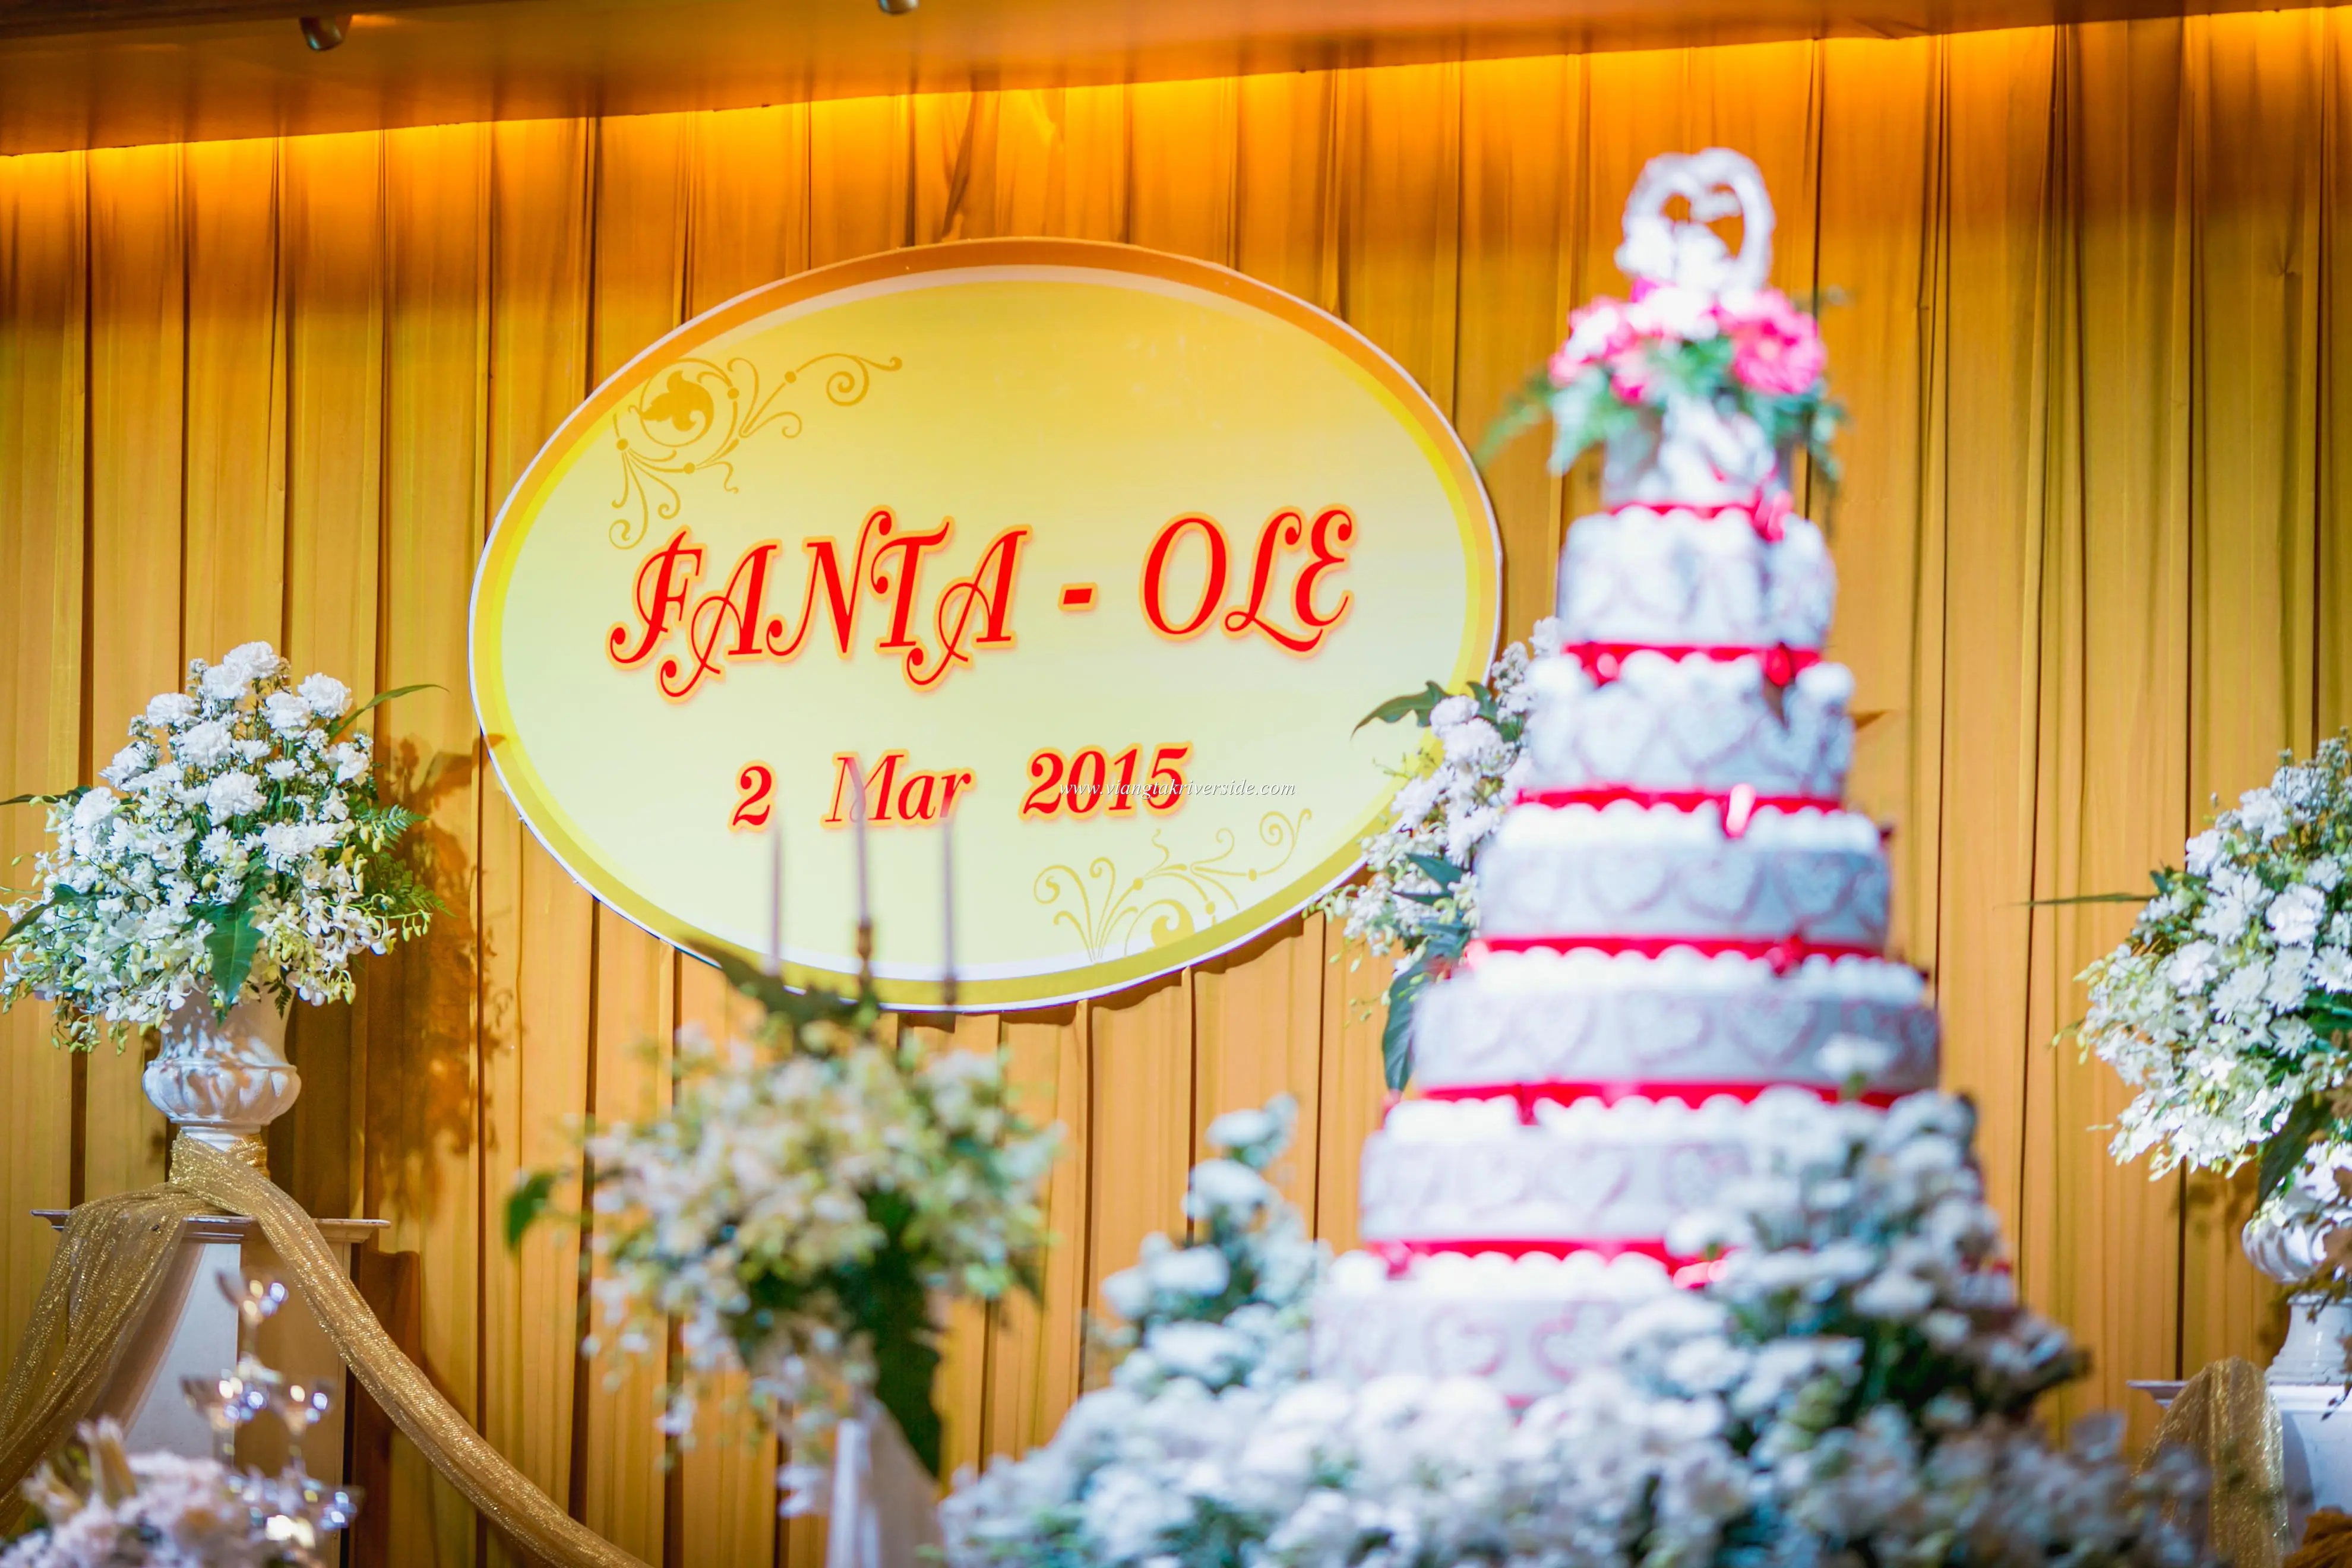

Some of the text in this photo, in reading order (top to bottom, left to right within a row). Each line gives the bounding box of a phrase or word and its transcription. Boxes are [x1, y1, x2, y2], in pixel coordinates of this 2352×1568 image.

[609, 508, 1353, 698] FANTA - OLE
[732, 747, 1188, 827] 2 Mar 2015
